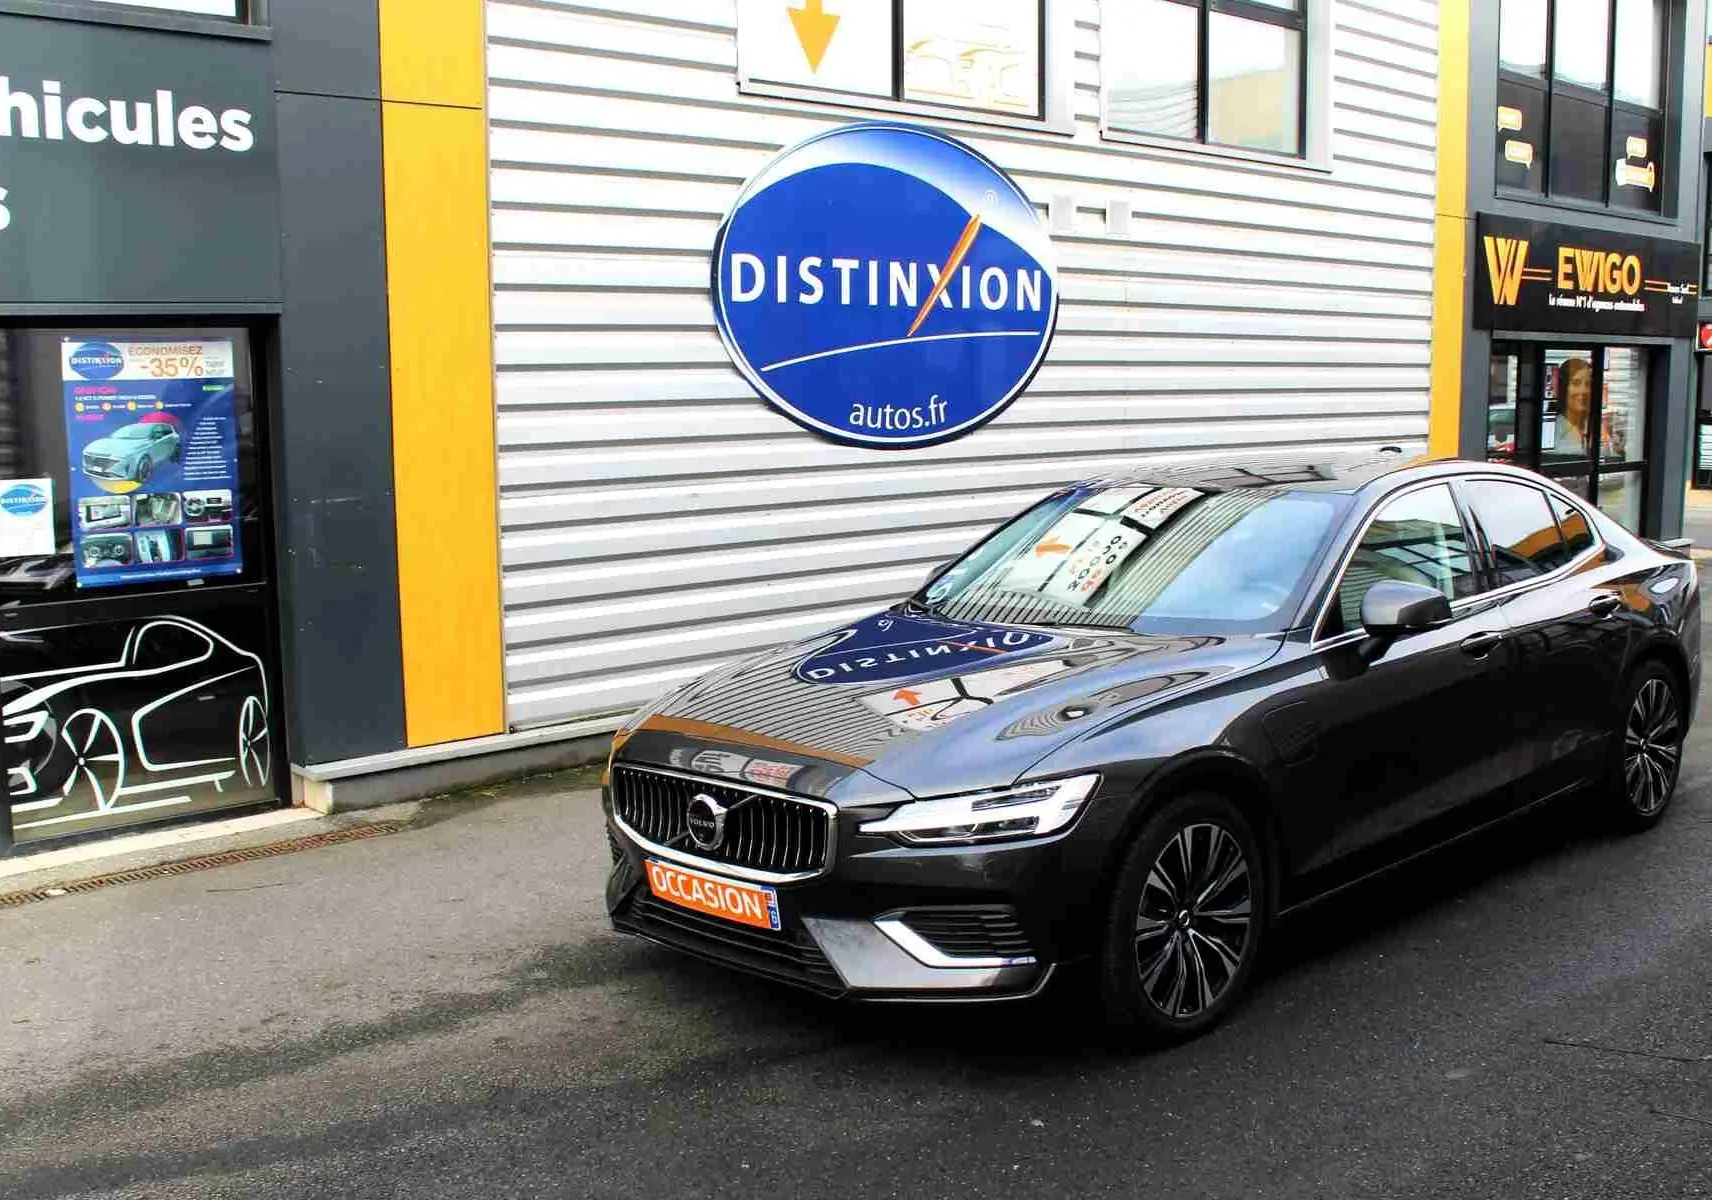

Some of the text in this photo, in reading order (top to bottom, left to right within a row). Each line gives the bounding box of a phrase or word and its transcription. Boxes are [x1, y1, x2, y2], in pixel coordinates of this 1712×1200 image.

[0, 76, 254, 152] hicules
[730, 246, 1042, 316] DISTINXION
[1557, 246, 1642, 296] EWIGO
[140, 356, 203, 378] -35%
[849, 394, 948, 431] autos.fr
[651, 865, 763, 920] OCCASION
